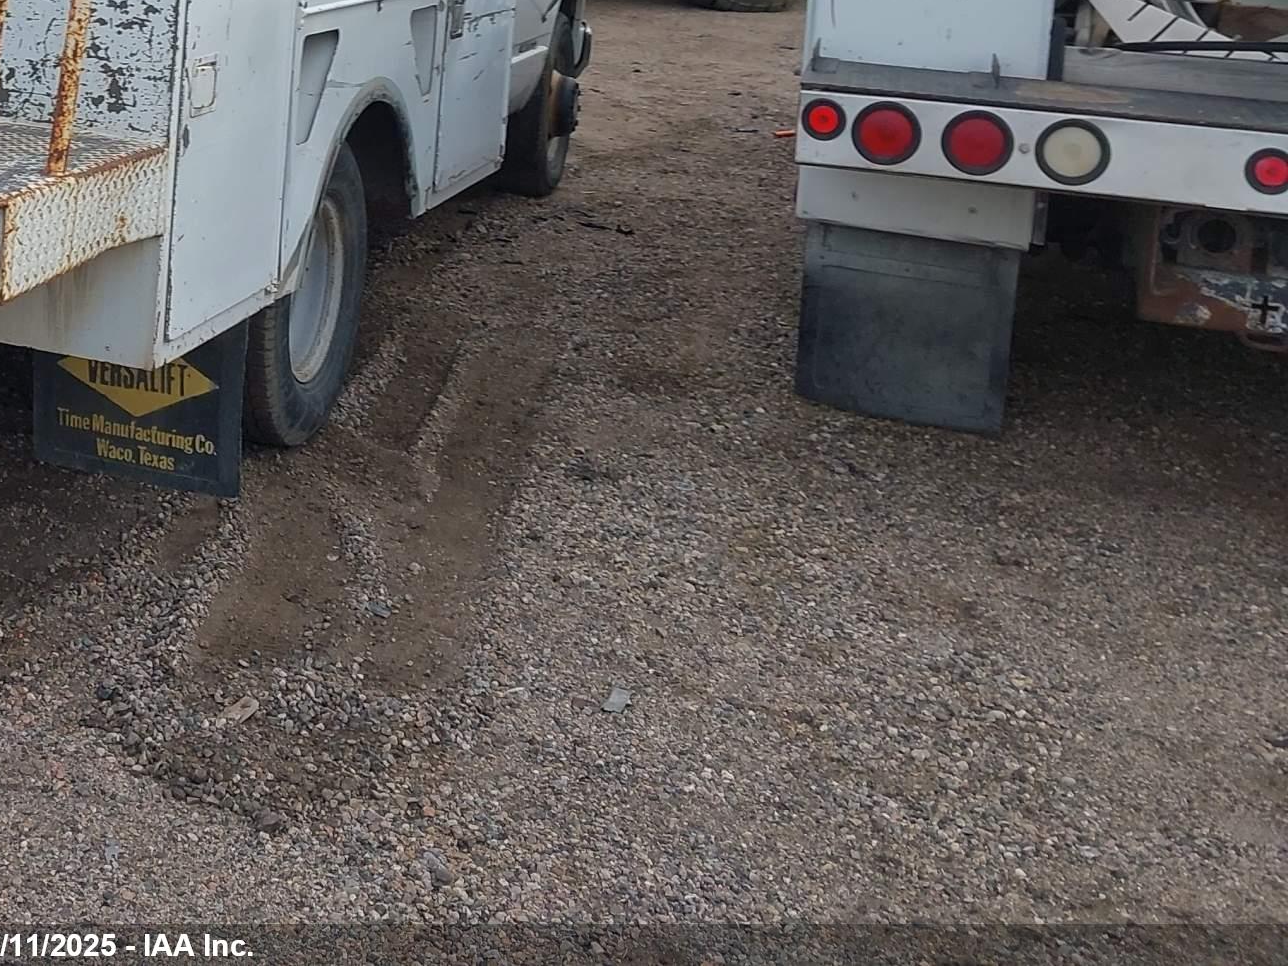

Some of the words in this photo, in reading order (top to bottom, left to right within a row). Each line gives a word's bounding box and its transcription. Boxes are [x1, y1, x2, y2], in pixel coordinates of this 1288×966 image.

[57, 407, 90, 431] Time
[92, 413, 194, 455] Manufacturing
[137, 445, 175, 471] Texas
